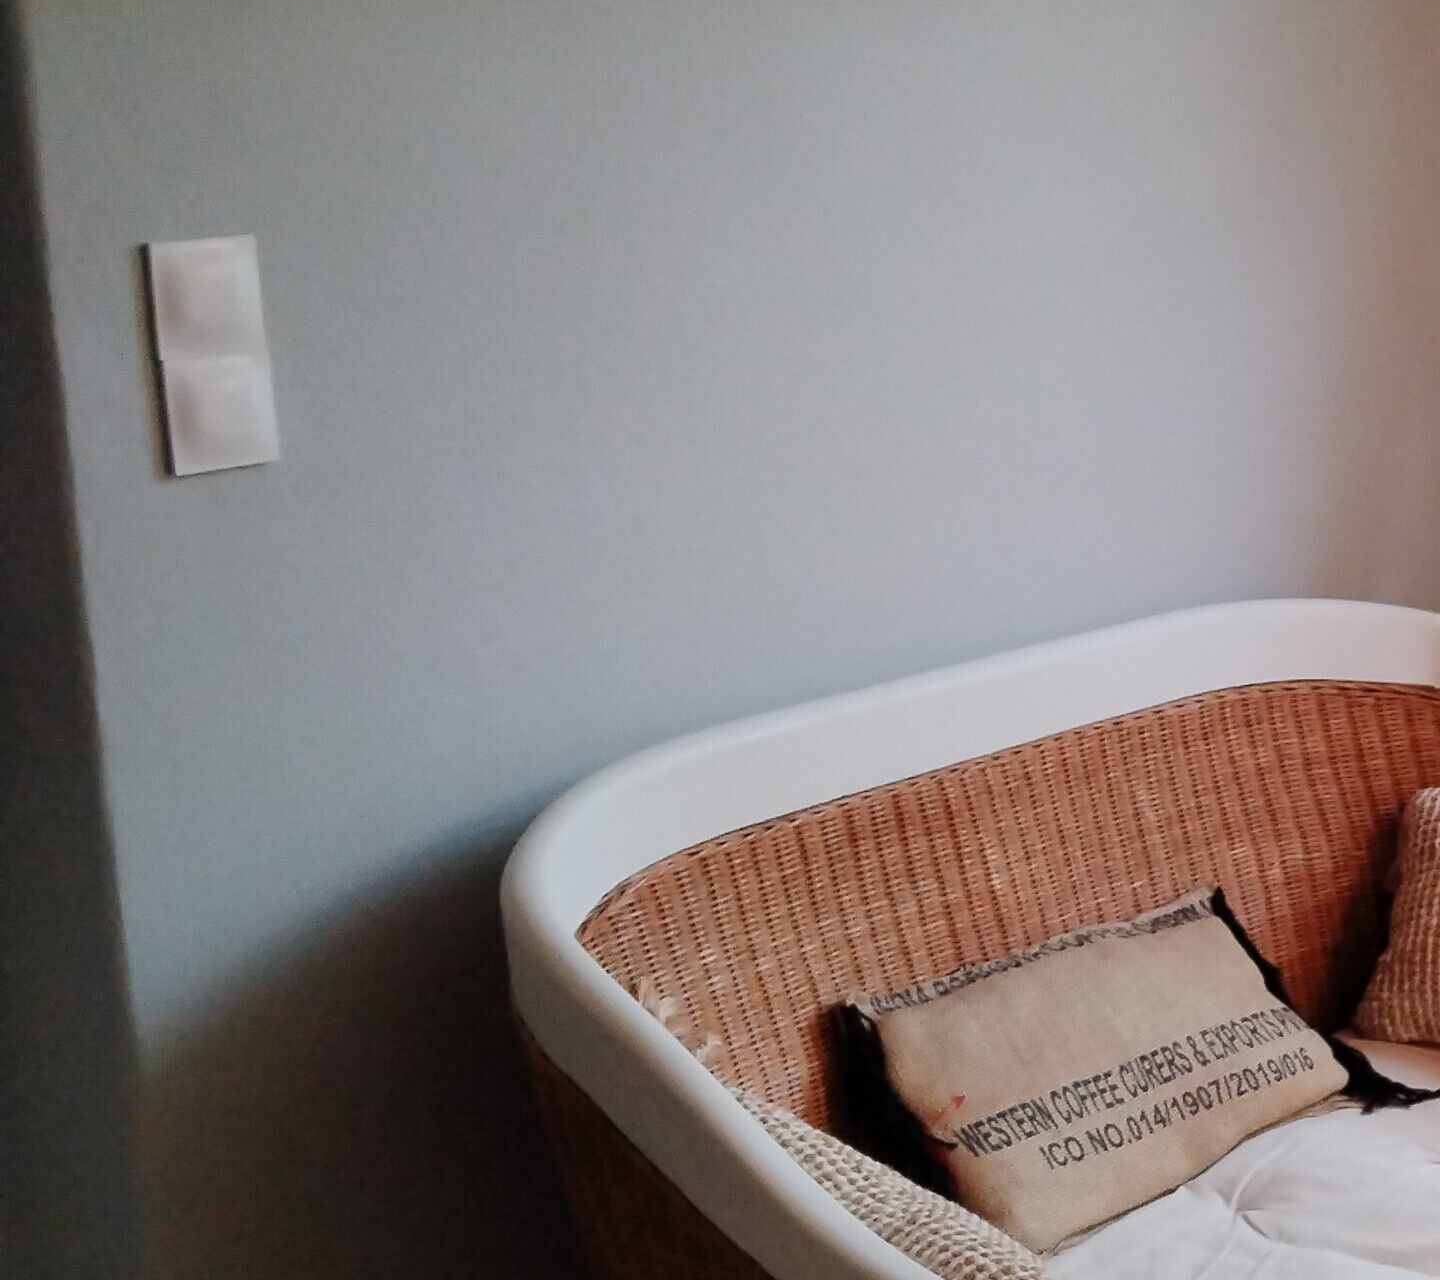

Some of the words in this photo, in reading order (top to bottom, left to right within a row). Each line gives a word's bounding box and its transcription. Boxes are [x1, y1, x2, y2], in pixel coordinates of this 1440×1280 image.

[954, 1096, 1059, 1158] WESTERN
[1050, 1070, 1125, 1124] COFFEE
[1119, 1040, 1193, 1099] CURERS
[1186, 1035, 1212, 1067] &
[1199, 1010, 1284, 1061] EXPORTS
[1038, 1135, 1086, 1170] ICO
